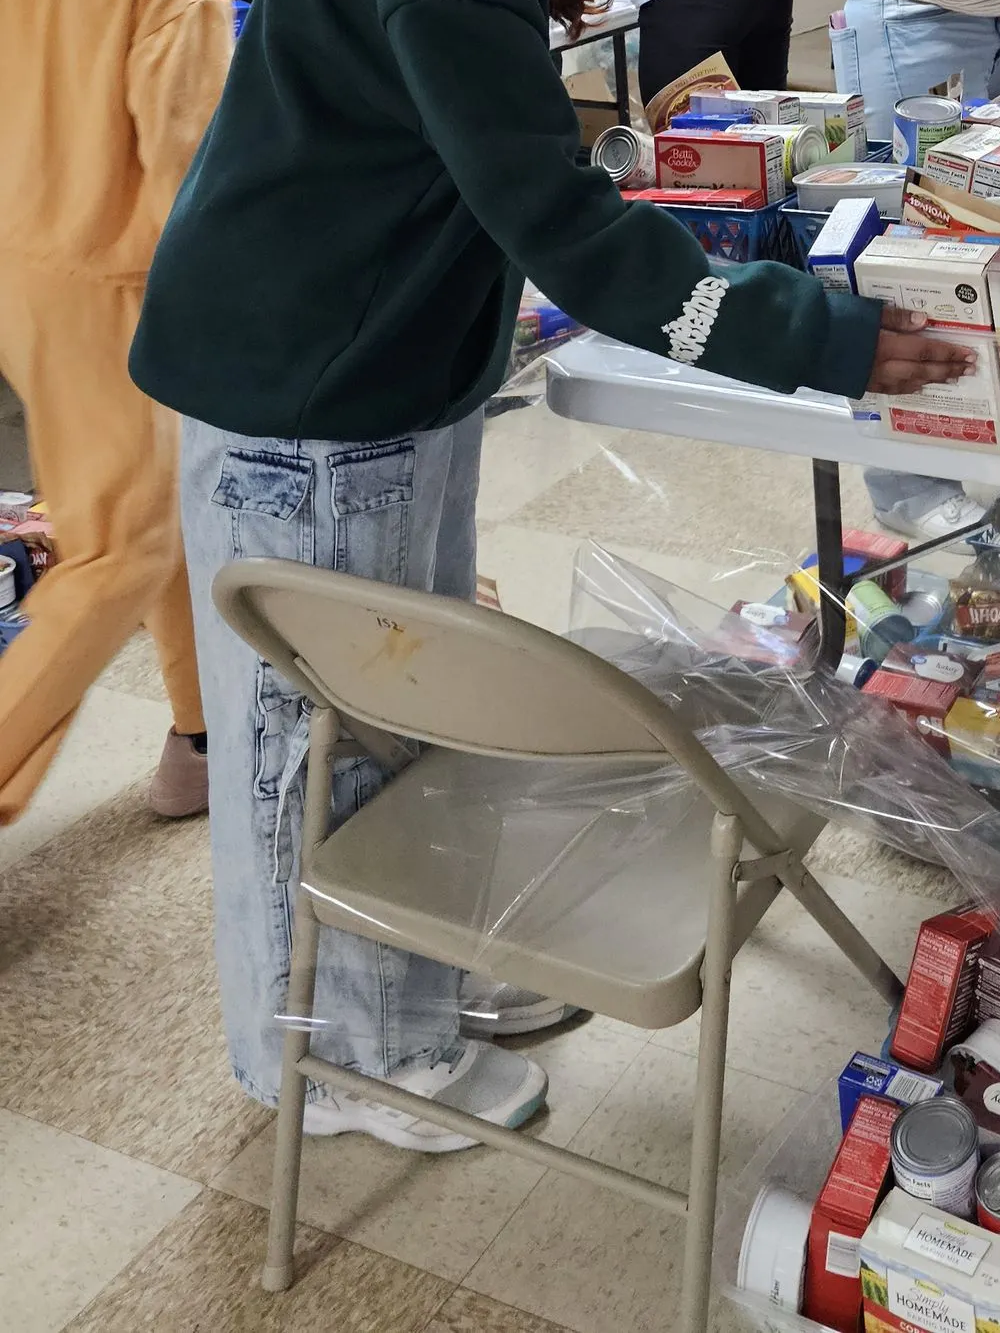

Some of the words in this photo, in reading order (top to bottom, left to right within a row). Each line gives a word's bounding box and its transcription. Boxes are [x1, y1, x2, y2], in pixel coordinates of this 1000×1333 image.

[666, 156, 700, 168] Crocker
[672, 147, 694, 162] Betty
[928, 165, 950, 175] Nutrition
[950, 172, 967, 180] Facts
[908, 196, 950, 223] IDAHOAN
[913, 1178, 931, 1189] Facts
[916, 1229, 975, 1260] HOMEMADE
[896, 1292, 968, 1331] HOMEMADE
[909, 1287, 950, 1315] Simply
